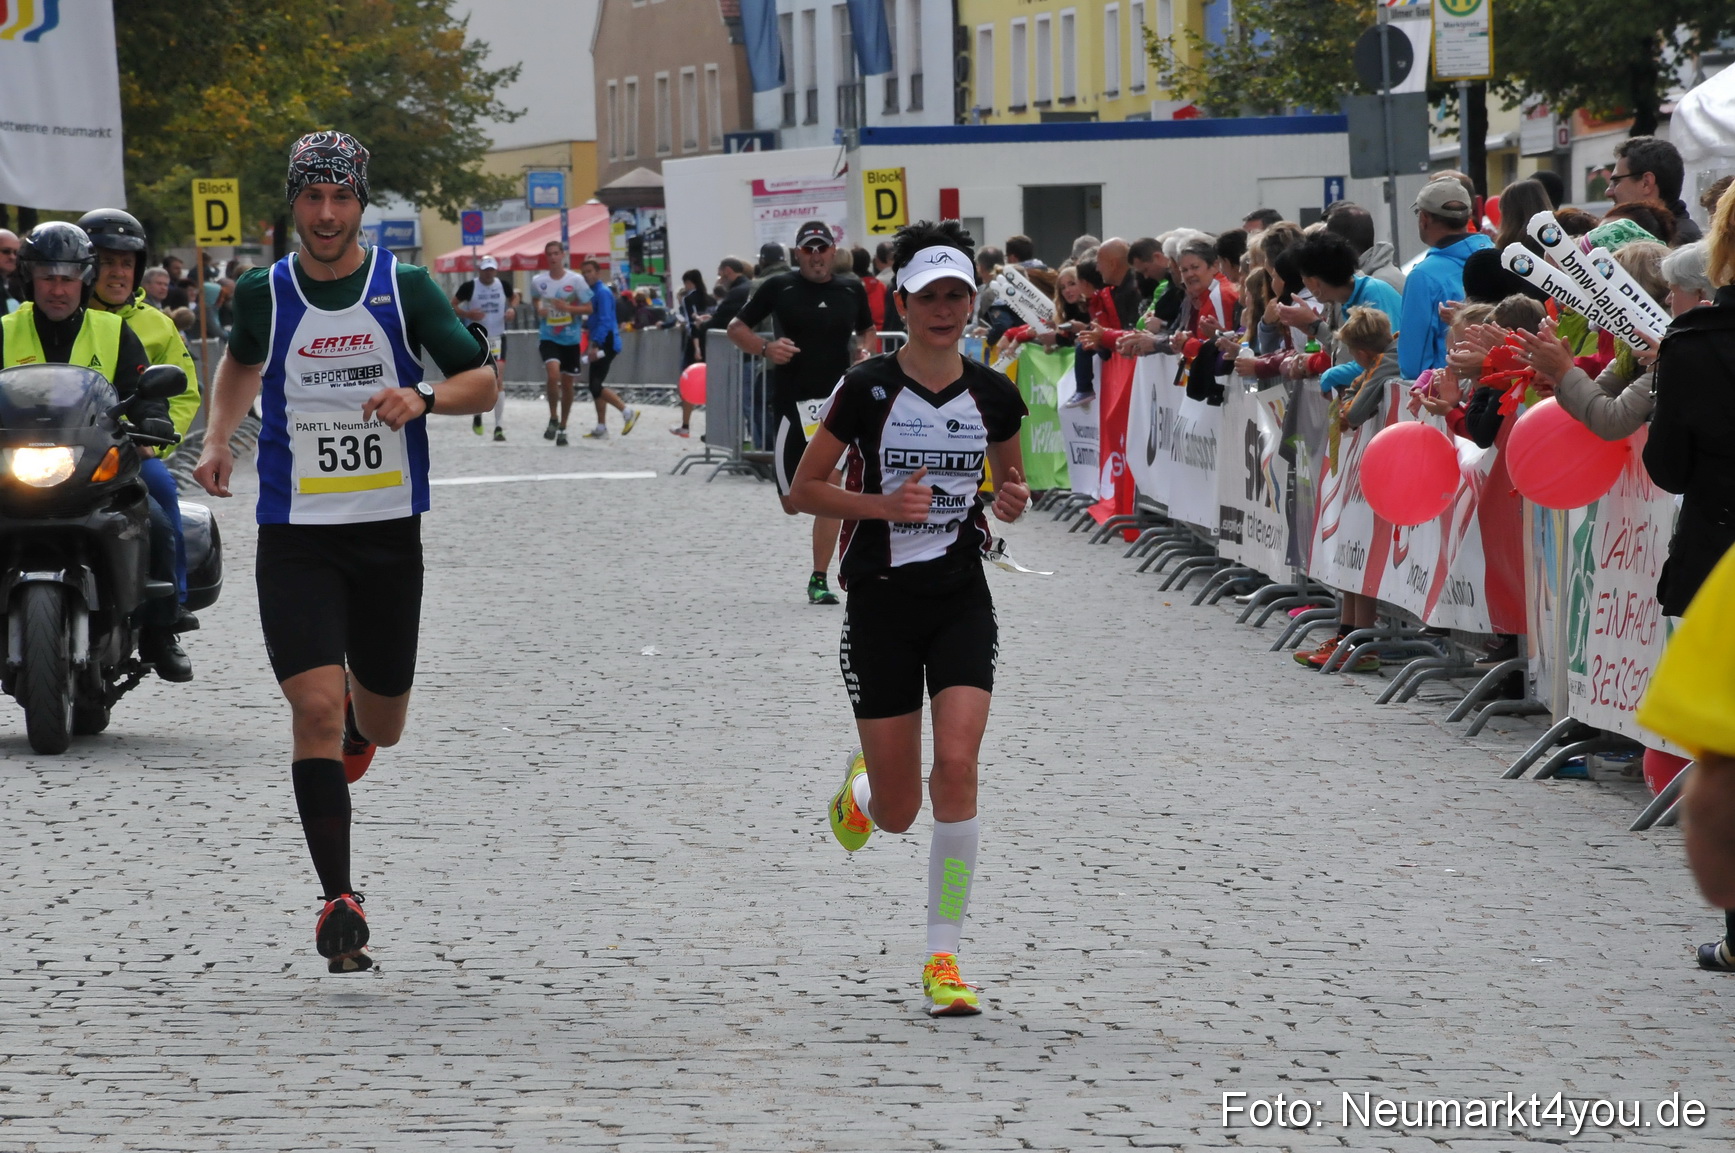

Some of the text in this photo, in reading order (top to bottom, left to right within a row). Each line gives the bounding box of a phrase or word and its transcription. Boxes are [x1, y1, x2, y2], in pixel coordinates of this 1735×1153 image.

[52, 125, 113, 139] neumarkt
[867, 170, 902, 185] Block
[198, 181, 234, 195] Block
[875, 188, 899, 221] D
[206, 199, 230, 231] D
[310, 333, 374, 350] ERTEL
[310, 344, 374, 355] AUTOMOBILE
[314, 365, 381, 384] SPORTWEISS
[358, 379, 378, 387] Sport.
[295, 419, 383, 432] PARTL Neumarkt
[317, 433, 383, 473] 536
[887, 451, 983, 470] POSITIV
